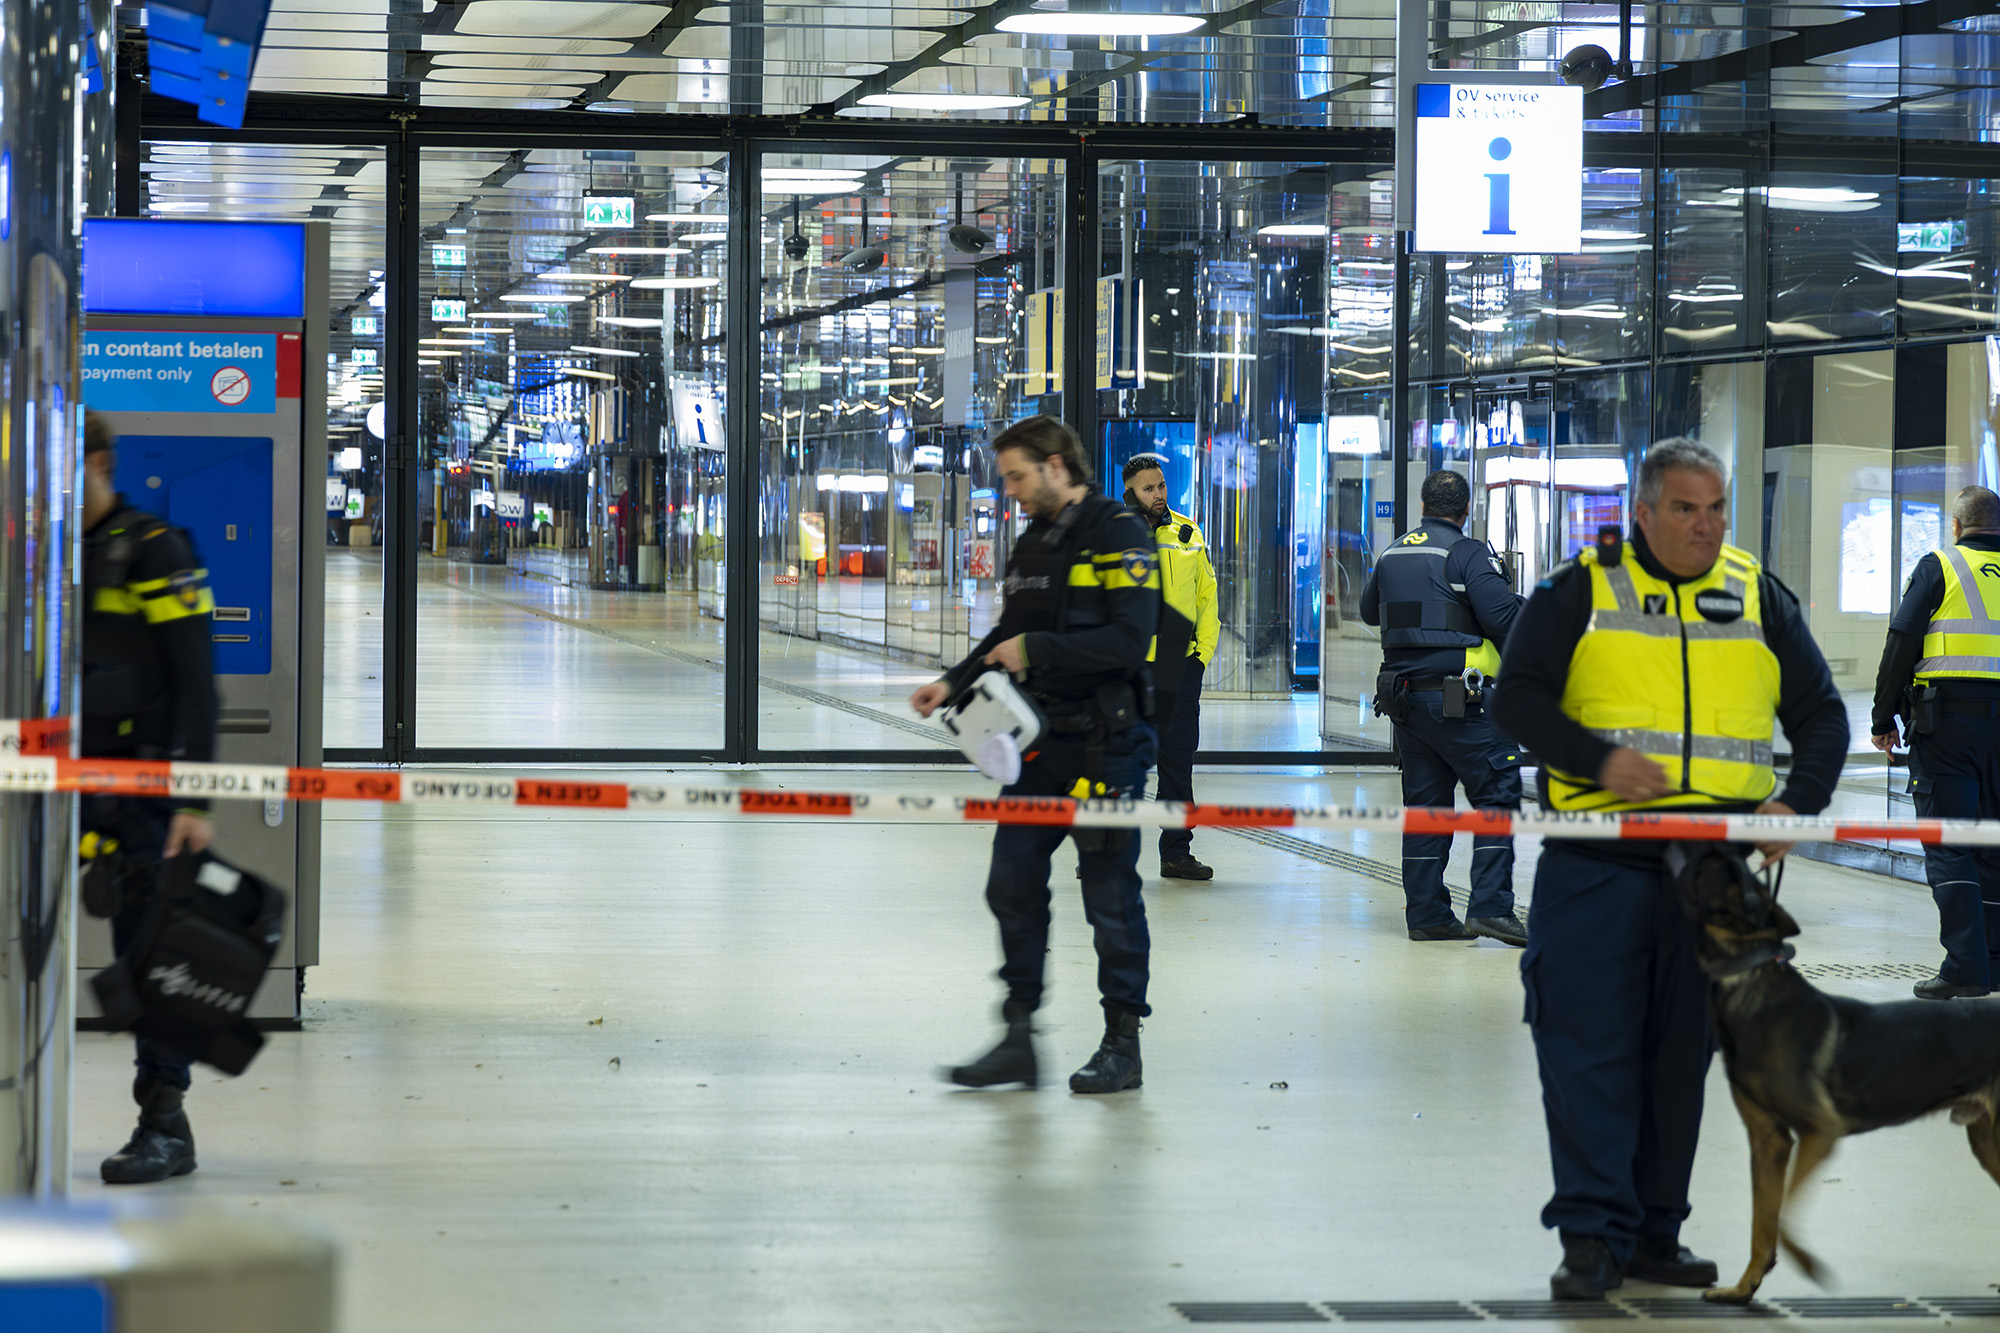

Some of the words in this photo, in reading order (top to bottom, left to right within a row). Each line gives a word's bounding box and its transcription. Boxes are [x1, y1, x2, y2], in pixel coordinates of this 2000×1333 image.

[1457, 88, 1480, 102] OV
[1485, 89, 1540, 103] service
[1456, 106, 1466, 119] &
[1473, 107, 1525, 119] tickets
[105, 341, 184, 358] contant
[189, 341, 264, 359] betalen
[82, 367, 153, 382] payment
[156, 366, 193, 383] only
[1377, 505, 1390, 514] H9
[136, 772, 252, 793] TOEGANG
[262, 777, 327, 793] GEEN
[413, 780, 526, 799] TOEGANG
[537, 785, 600, 801] GEEN
[686, 789, 798, 807] TOEGANG
[807, 793, 871, 808] GEEN
[954, 797, 1065, 812] TOEGANG
[1076, 798, 1136, 813] GEEN
[1218, 804, 1330, 818] TOEGANG
[1338, 805, 1399, 819] GEEN
